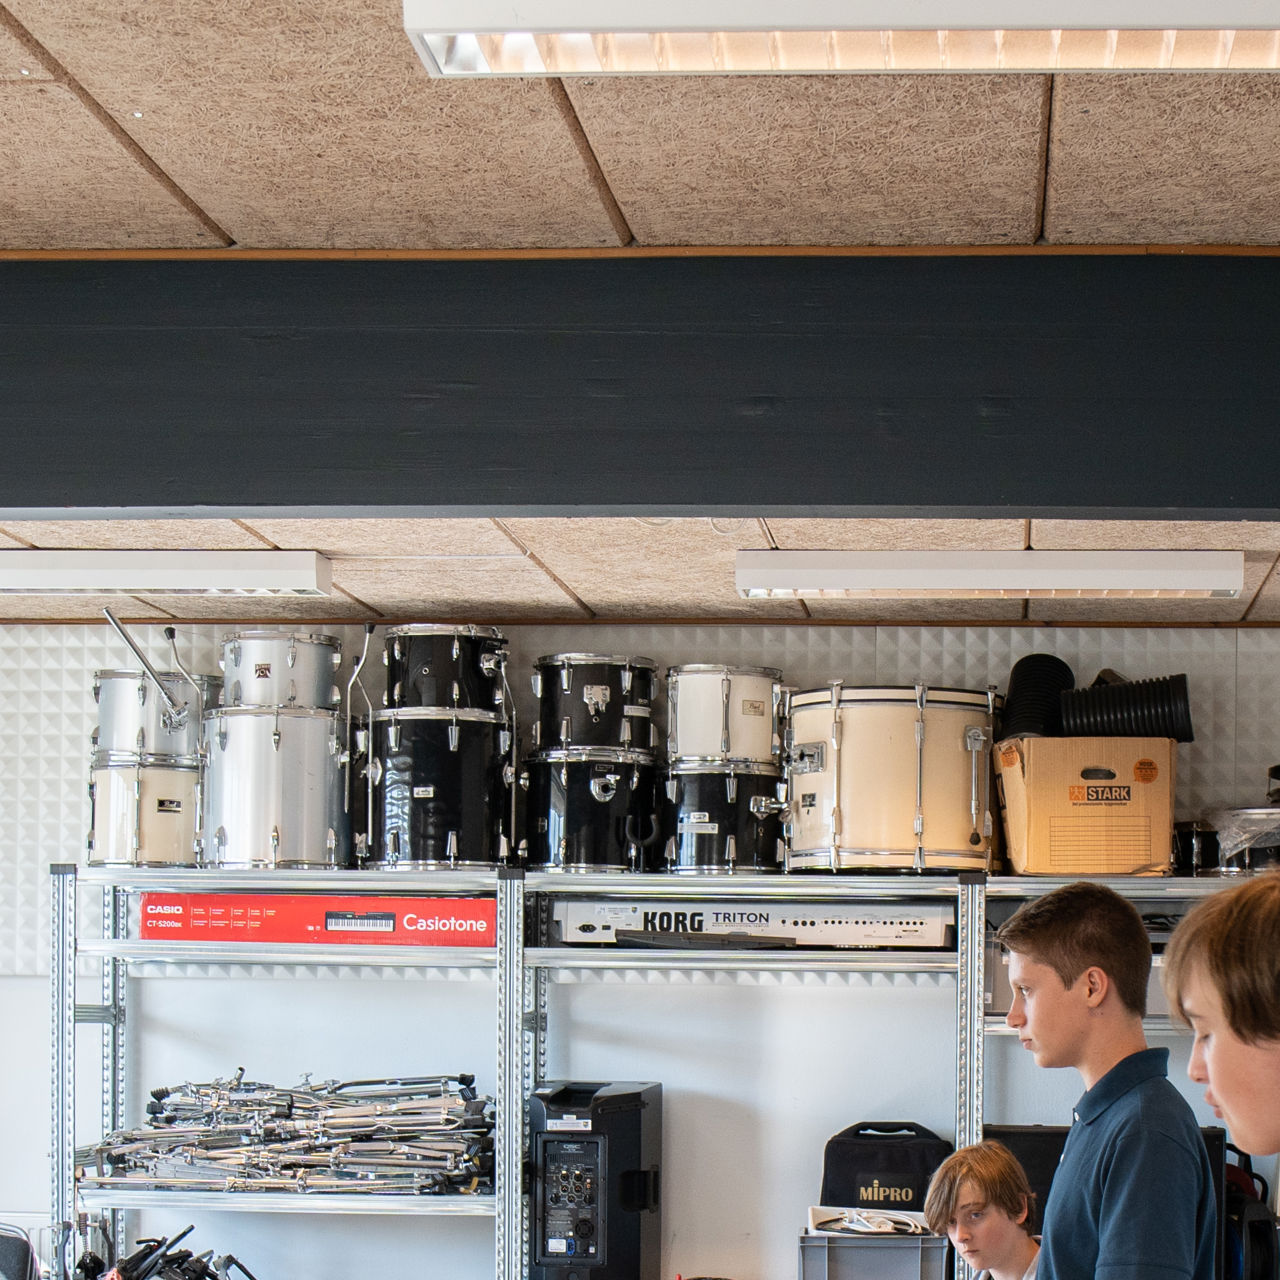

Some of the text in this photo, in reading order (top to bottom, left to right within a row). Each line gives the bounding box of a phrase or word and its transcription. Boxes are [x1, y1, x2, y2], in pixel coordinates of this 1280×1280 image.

[1088, 787, 1129, 800] STARK
[147, 905, 183, 914] CASIO
[403, 914, 487, 932] Casiotone
[643, 912, 704, 932] KORG
[712, 912, 770, 923] TRITON
